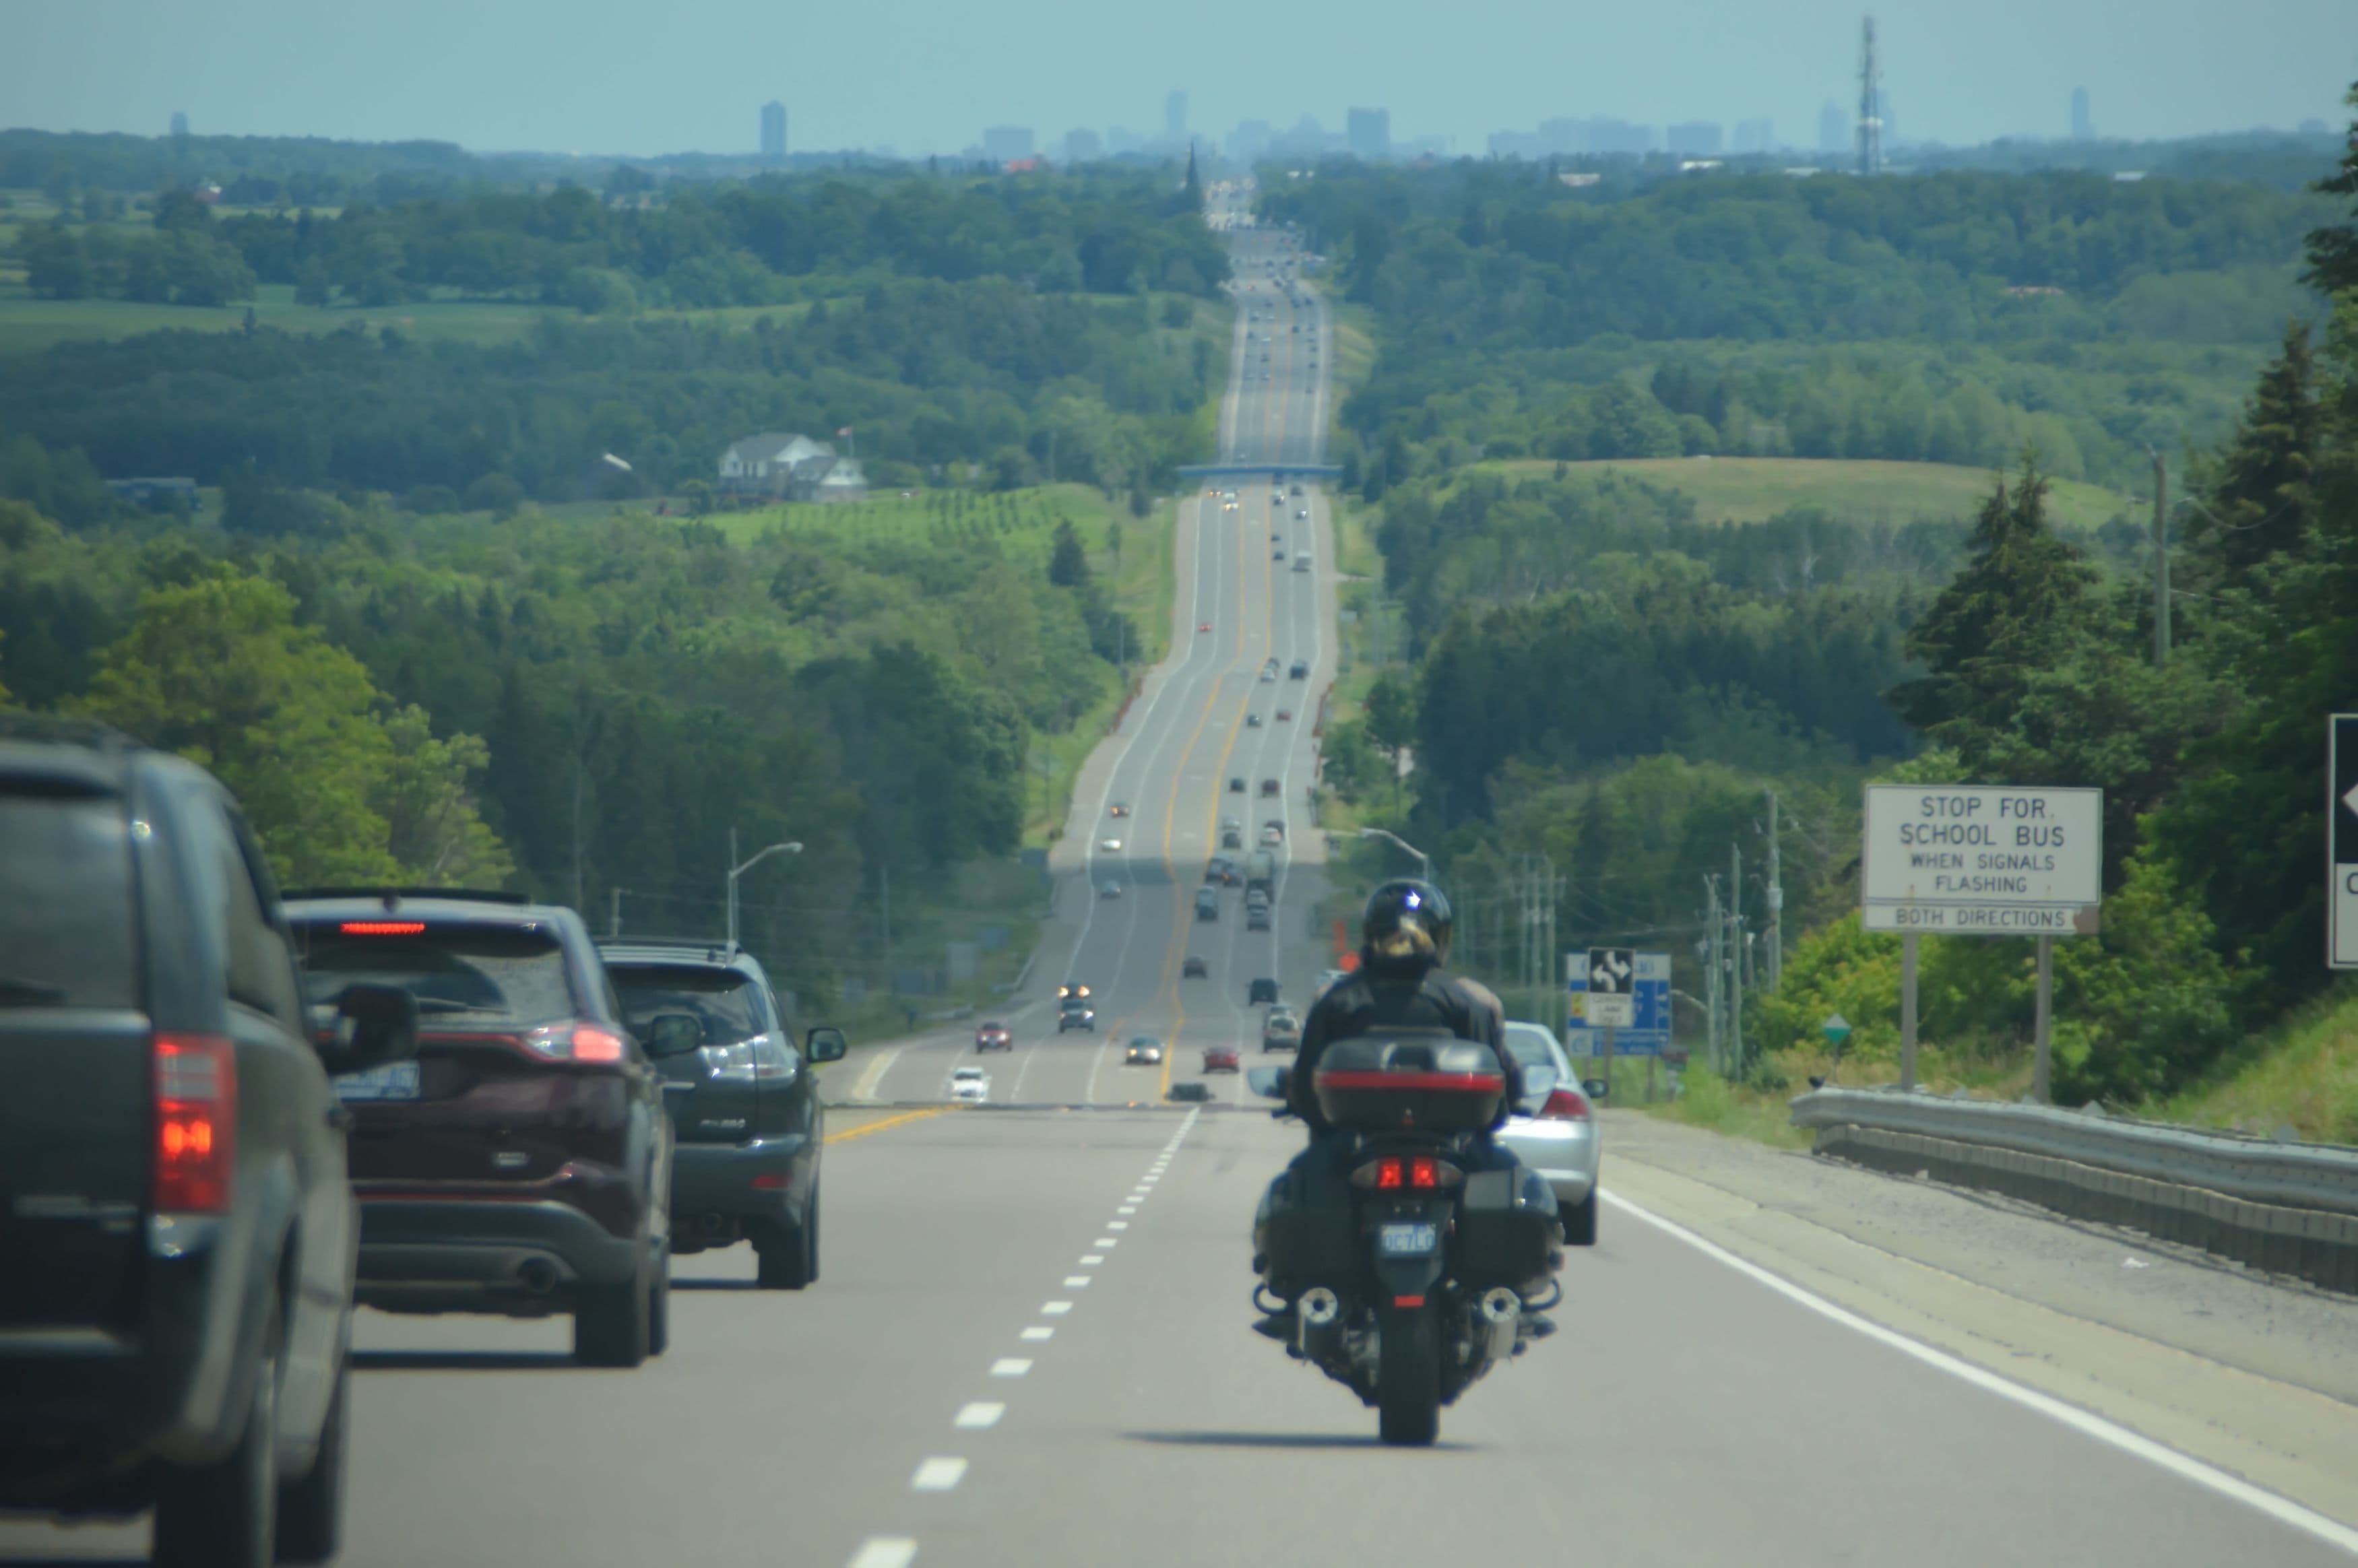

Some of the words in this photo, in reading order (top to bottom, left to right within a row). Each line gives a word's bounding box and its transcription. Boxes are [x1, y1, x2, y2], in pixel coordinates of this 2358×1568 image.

[1921, 796, 1981, 817] STOP
[2000, 797, 2045, 818] FOR
[1900, 824, 1996, 845] SCHOOL
[2016, 826, 2064, 847] BUS
[1911, 853, 1963, 868] WHEN
[1978, 854, 2055, 870] SIGNALS
[1936, 876, 2027, 893] FLASHING
[1896, 909, 1943, 925] BOTH
[1957, 909, 2065, 927] DIRECTIONS
